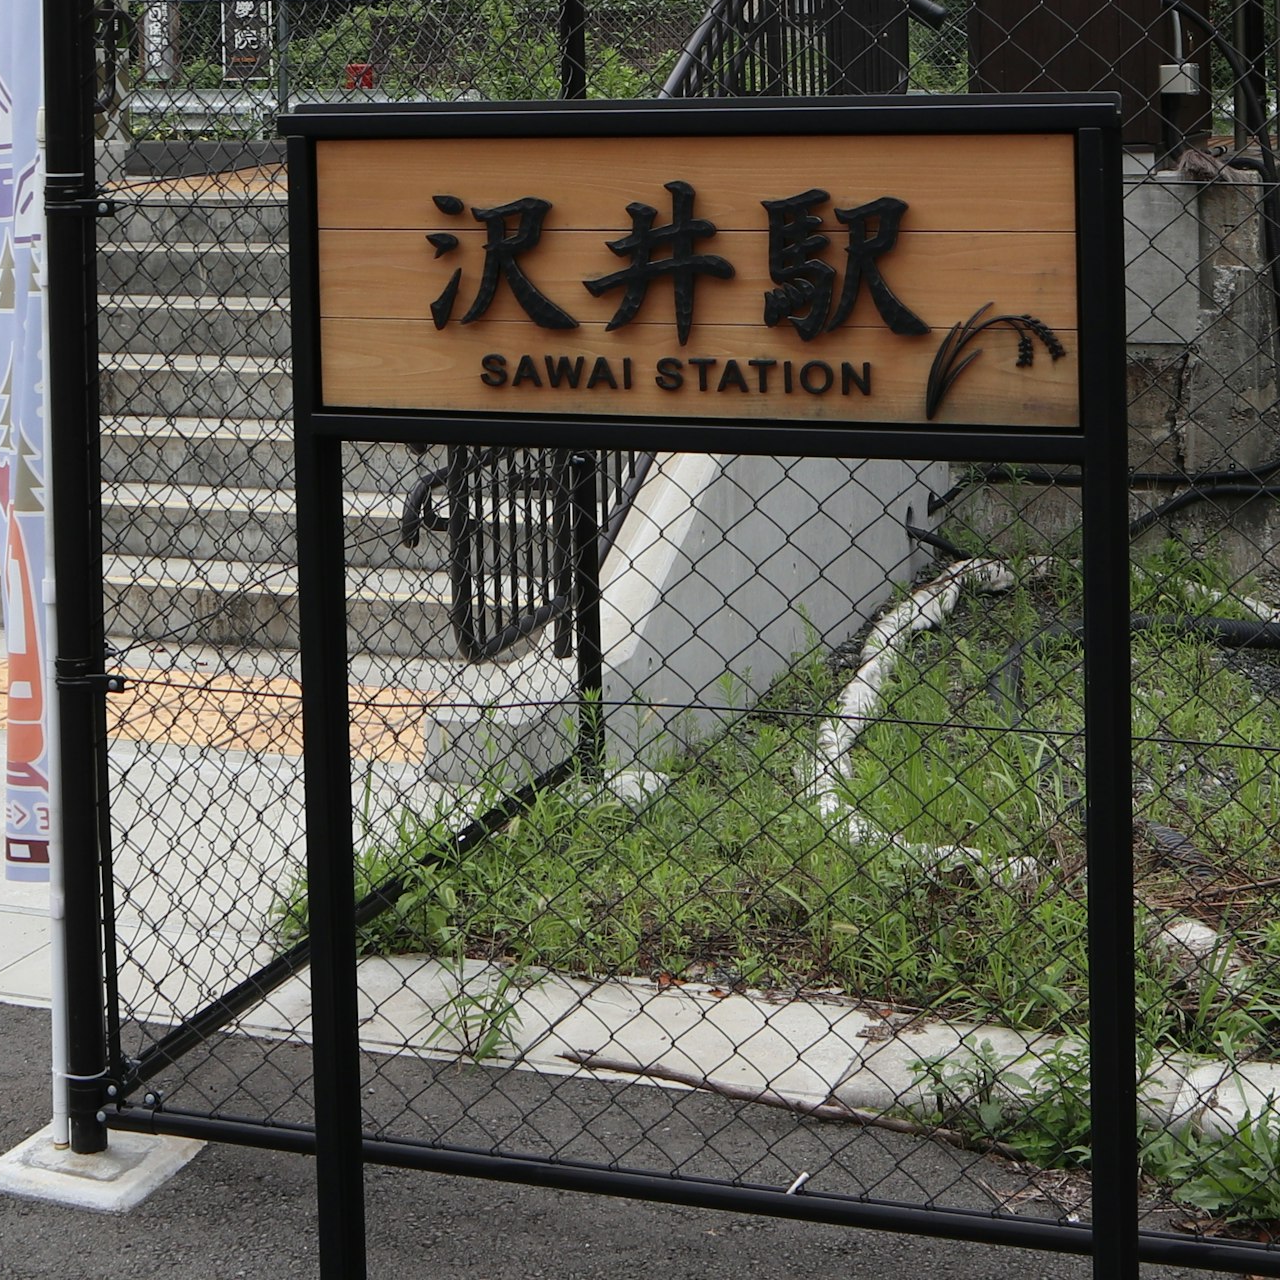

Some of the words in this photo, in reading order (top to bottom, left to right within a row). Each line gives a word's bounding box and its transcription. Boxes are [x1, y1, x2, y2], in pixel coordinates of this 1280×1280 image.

[425, 179, 932, 346] 沢井駅
[480, 353, 634, 390] SAWAI
[655, 355, 873, 397] STATION
